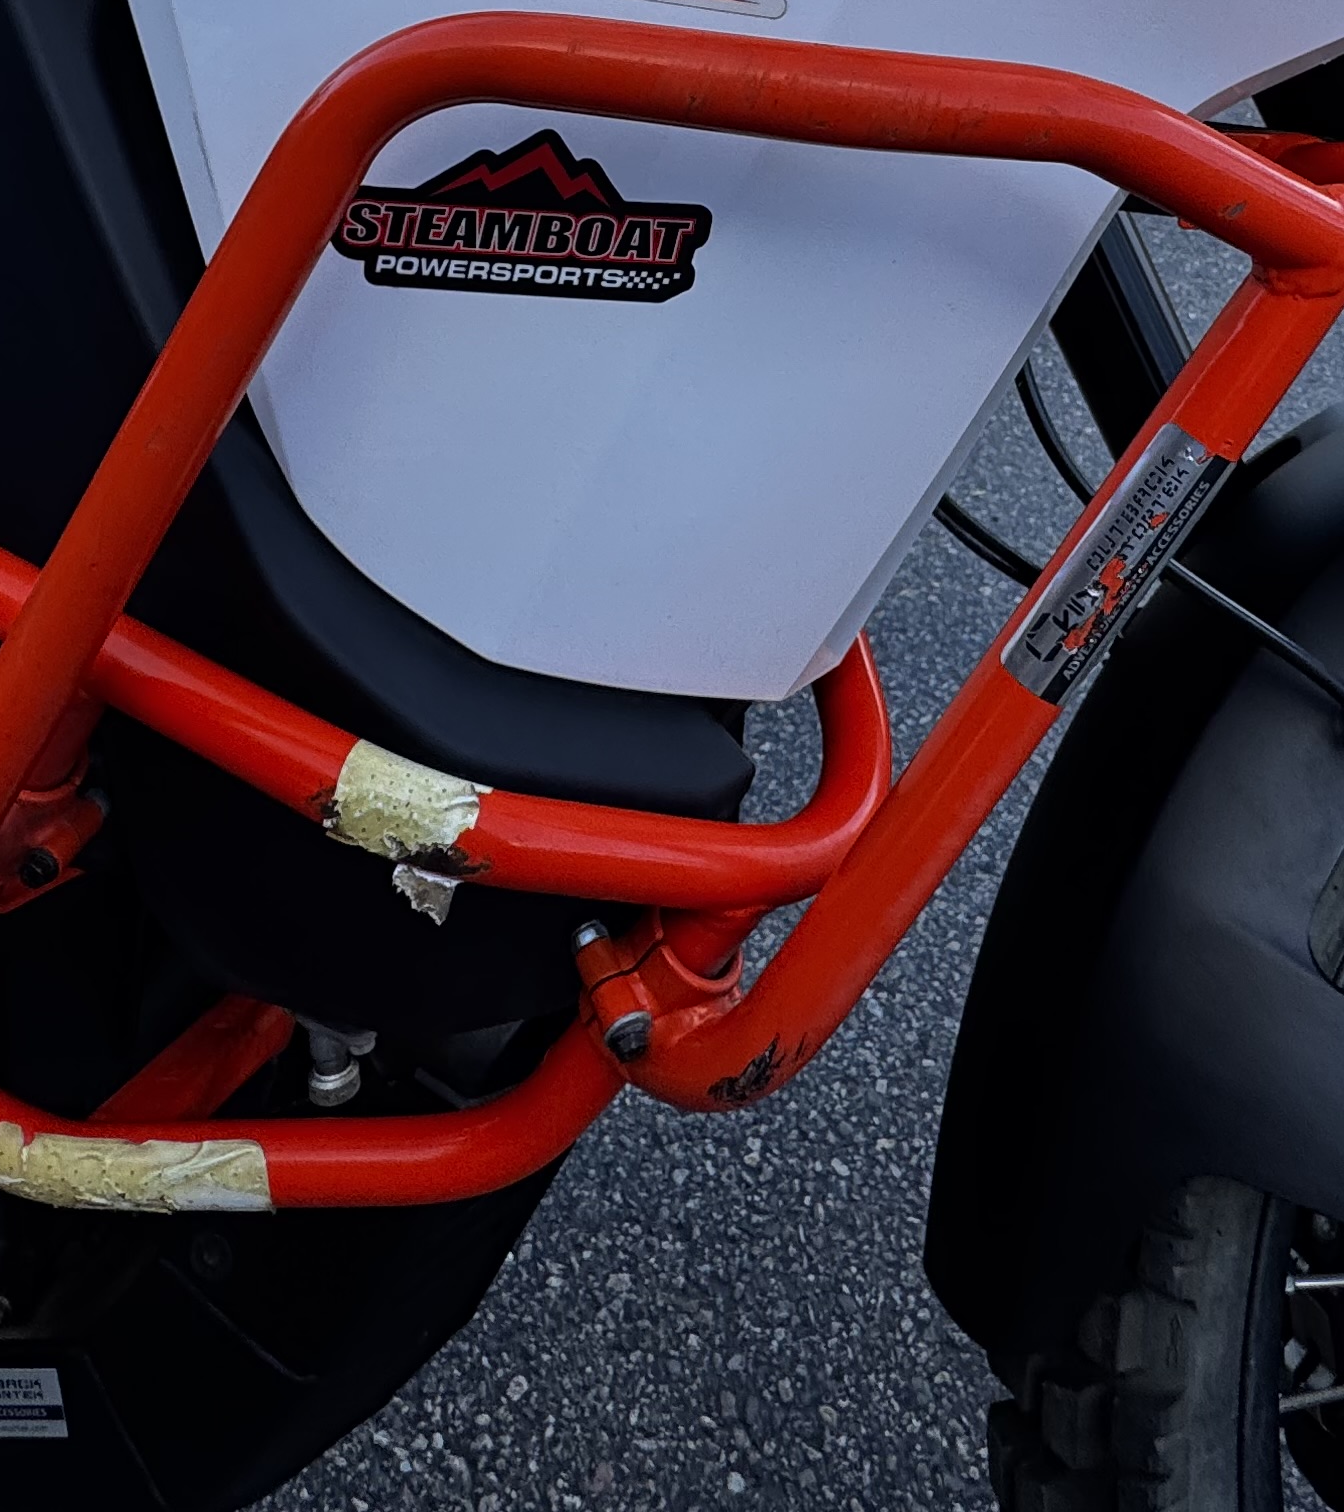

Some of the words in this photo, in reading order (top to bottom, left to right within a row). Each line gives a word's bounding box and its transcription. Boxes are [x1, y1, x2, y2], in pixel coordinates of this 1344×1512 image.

[343, 201, 697, 264] STEAMBOAT
[374, 254, 624, 289] POWERSPORTS
[1087, 455, 1175, 572] OUTBACK
[1147, 481, 1211, 566] ACCESSORIES
